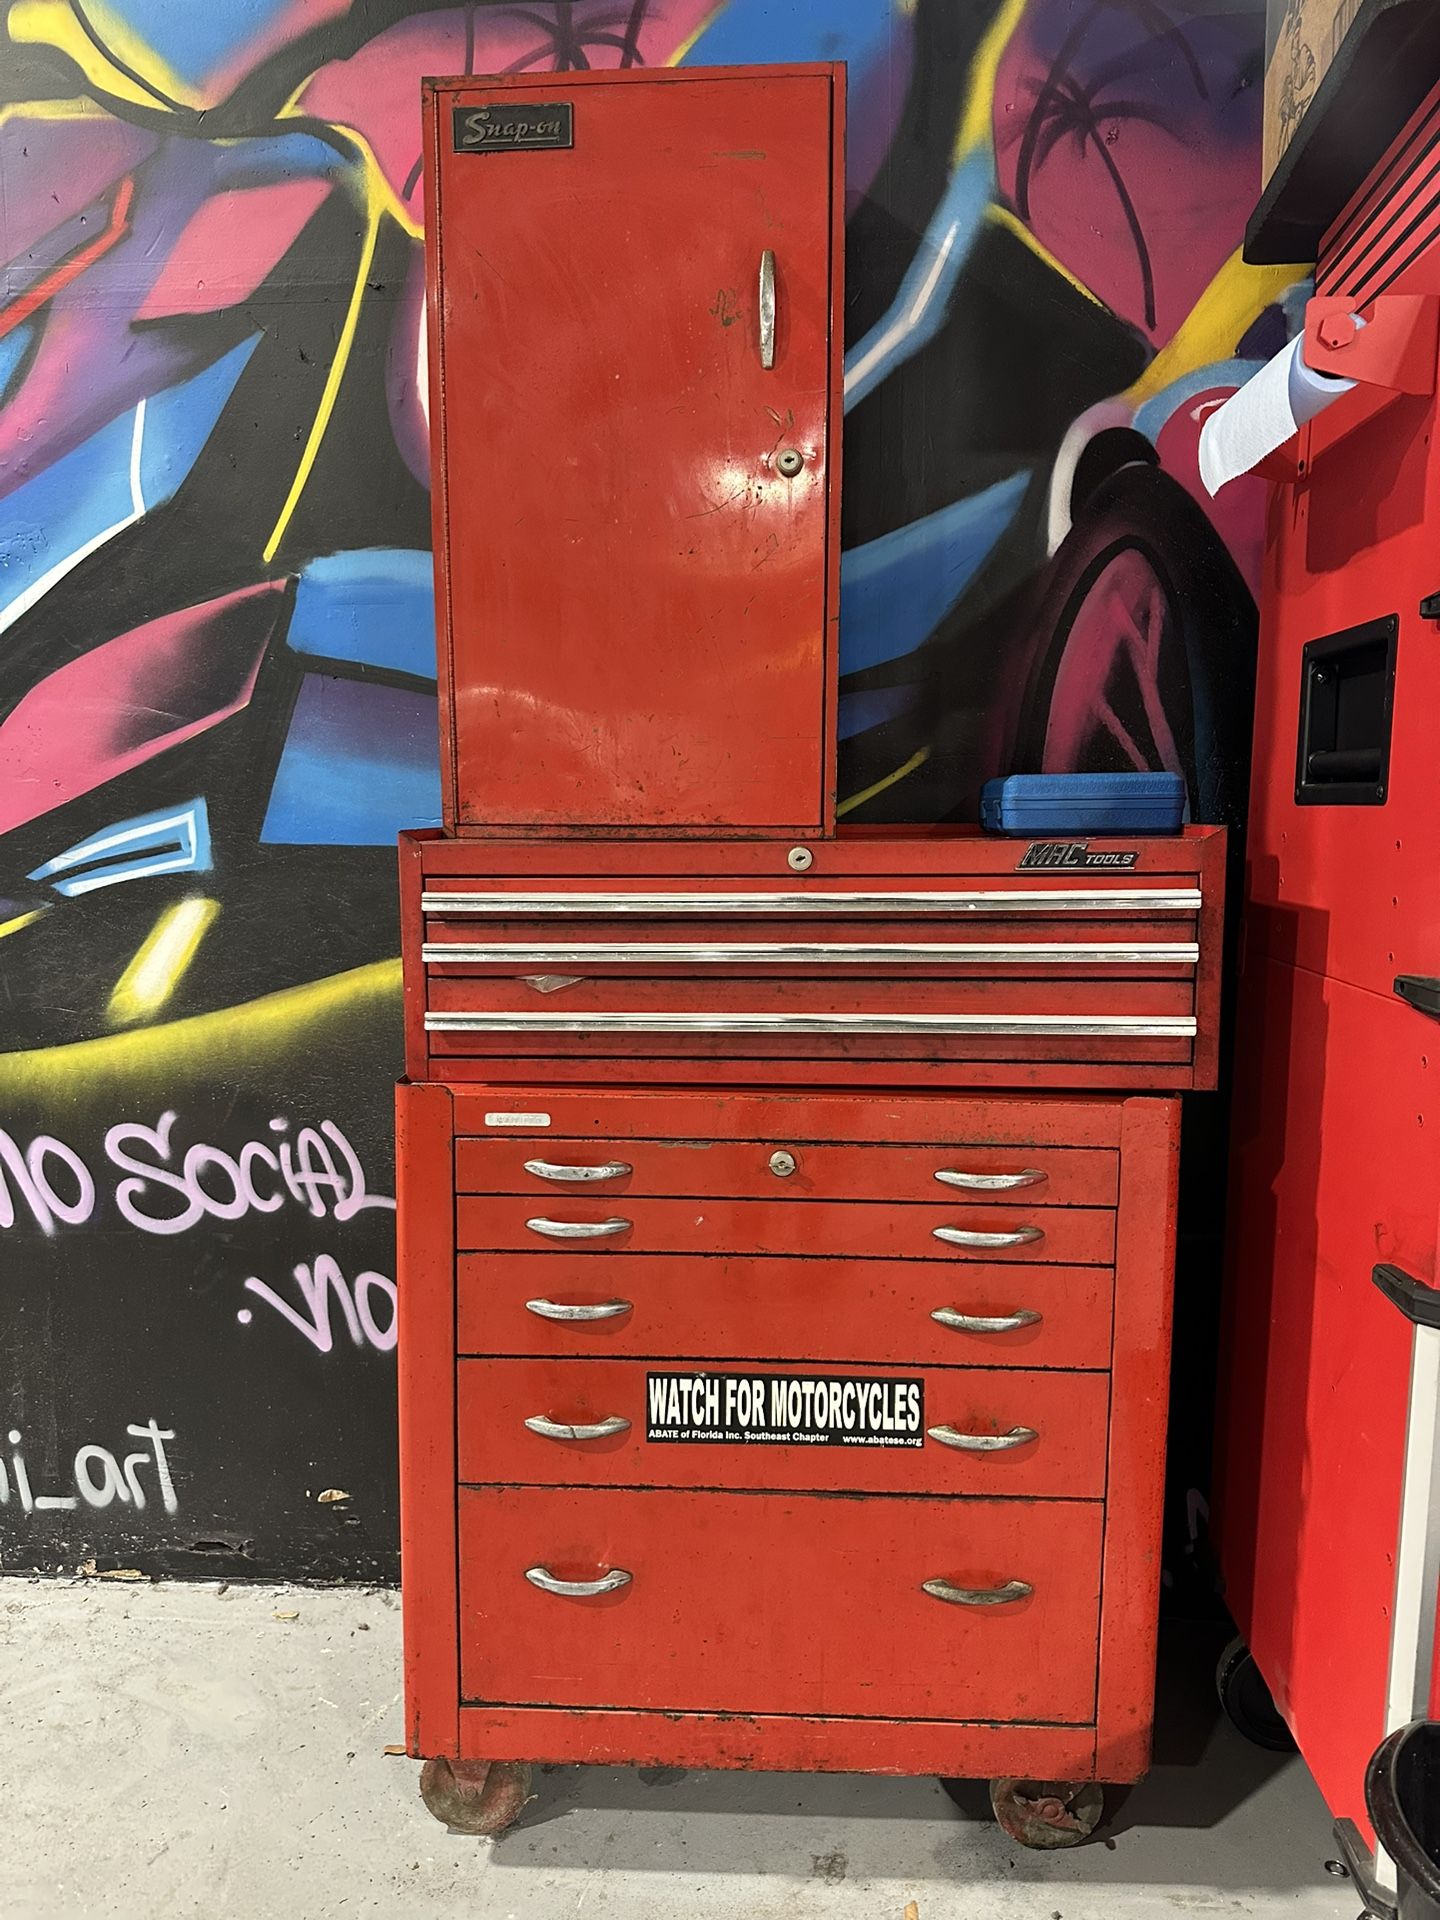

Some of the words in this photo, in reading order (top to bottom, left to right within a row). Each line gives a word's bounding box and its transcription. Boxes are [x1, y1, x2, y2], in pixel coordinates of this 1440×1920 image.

[463, 111, 561, 145] Snap-on
[1021, 842, 1088, 866] MAC
[1085, 854, 1135, 865] TOOLS
[648, 1378, 719, 1426] WATCH
[725, 1378, 766, 1427] FOR
[771, 1379, 920, 1432] MOTORCYCLES
[648, 1429, 679, 1439] ABATE
[680, 1430, 690, 1439] of
[692, 1430, 724, 1440] Florida
[725, 1431, 743, 1440] Inc.
[744, 1431, 791, 1441] Southeast
[792, 1432, 830, 1443] Chapter
